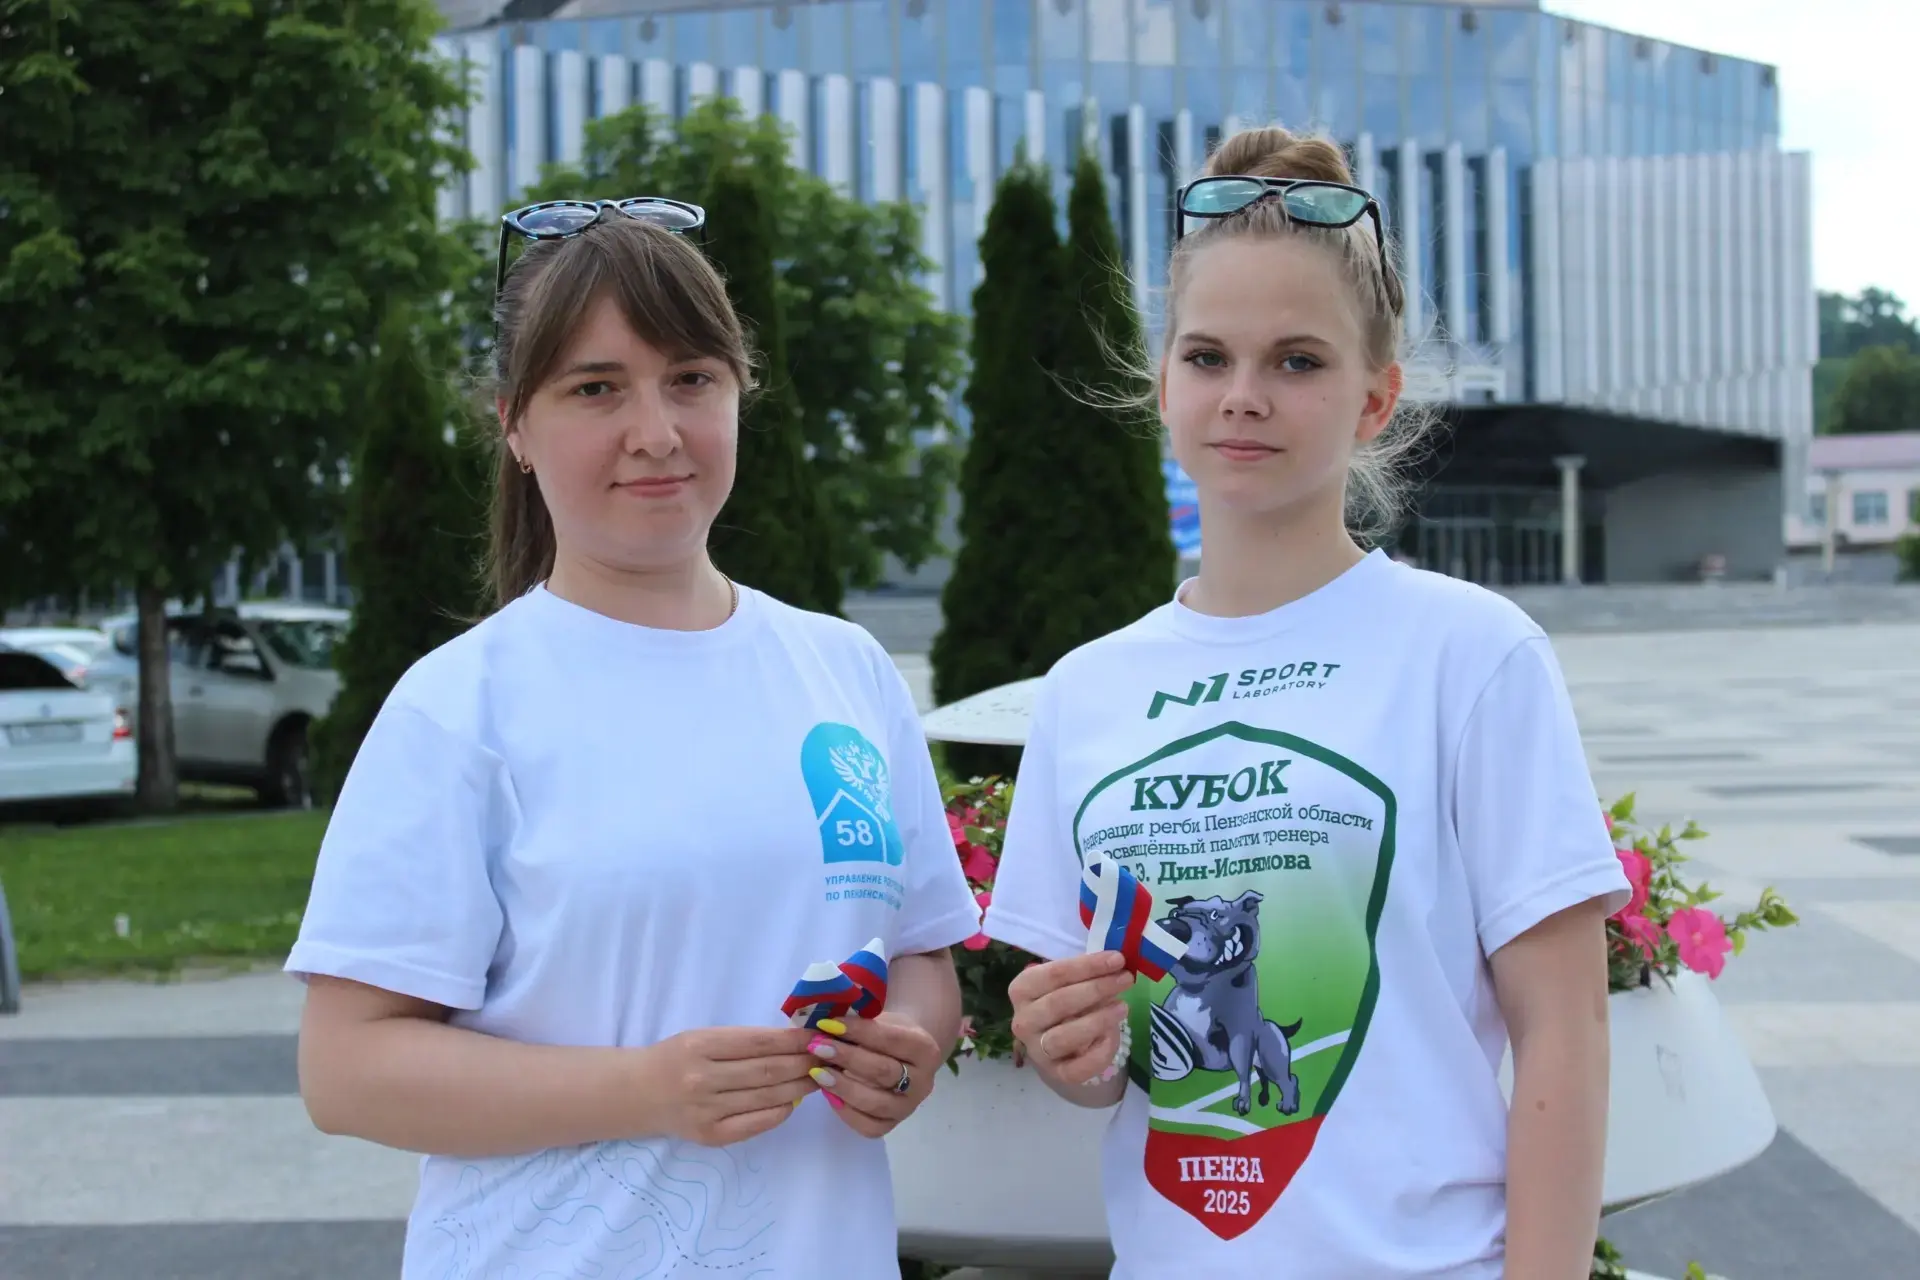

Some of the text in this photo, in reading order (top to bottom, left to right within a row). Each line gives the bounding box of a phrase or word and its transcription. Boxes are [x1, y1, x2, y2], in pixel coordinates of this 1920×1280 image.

[1237, 661, 1341, 687] SPORT
[1232, 680, 1327, 700] LABORATORY
[1129, 759, 1292, 811] КУБОК
[835, 819, 874, 847] 58
[1149, 817, 1201, 837] регби
[1204, 802, 1293, 832] Пензенской
[1298, 803, 1374, 831] области
[1102, 828, 1329, 860] освящённый памяти тренера
[824, 872, 883, 887] УПРАВЛЕНИЕ
[1157, 852, 1312, 885] Дин-Ислямова
[825, 890, 840, 902] ПО
[1177, 1155, 1265, 1184] ПЕНЗА
[1203, 1188, 1251, 1216] 2025
